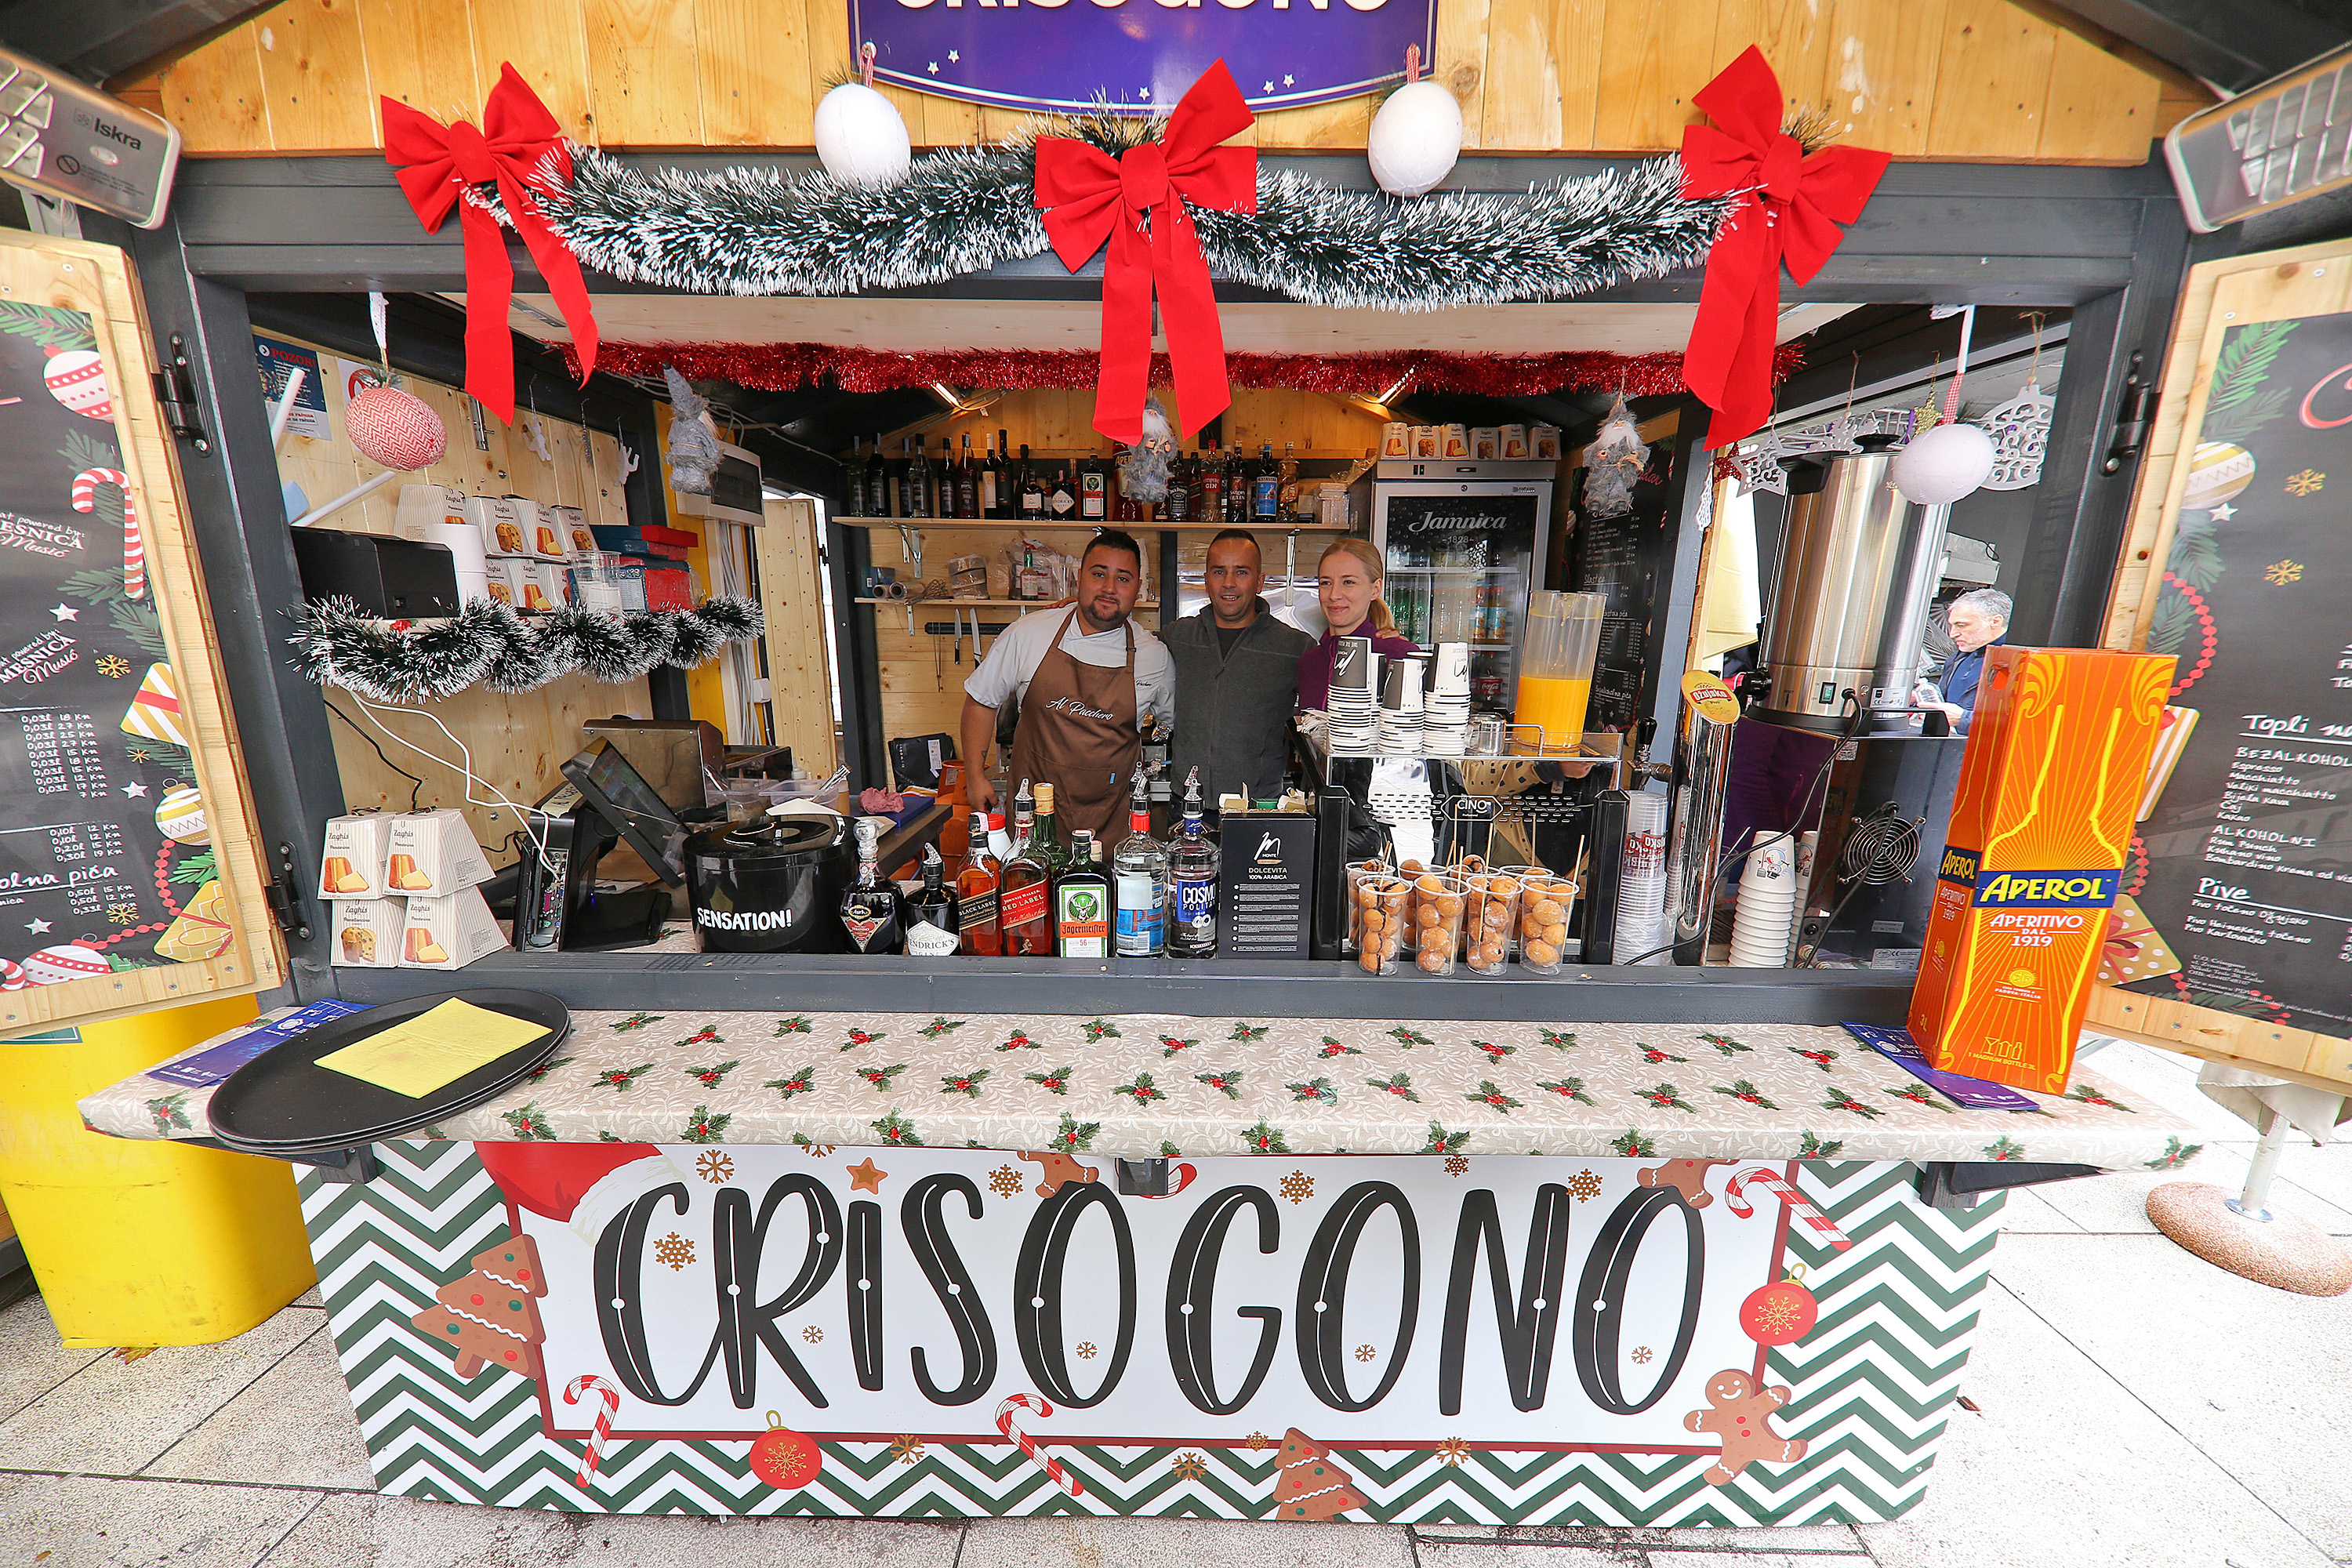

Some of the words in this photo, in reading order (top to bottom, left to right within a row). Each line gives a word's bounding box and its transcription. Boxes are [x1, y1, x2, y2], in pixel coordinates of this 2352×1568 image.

[94, 118, 142, 151] Iskra
[270, 348, 317, 368] POZOR!
[16, 517, 63, 532] powered
[1407, 511, 1508, 532] Jamnica
[0, 520, 85, 550] ESNICA
[11, 636, 45, 662] powered
[0, 635, 78, 684] MESNICA
[1693, 689, 1729, 701] Ožujsko
[1045, 696, 1069, 710] Al
[1069, 701, 1114, 720] Pacchero
[59, 713, 72, 721] 18
[2241, 713, 2310, 737] Topli
[61, 739, 78, 748] 27
[2234, 746, 2352, 768] BEZALKOHOL
[2230, 761, 2284, 773] Espresso
[2228, 772, 2301, 786] Macchiatto
[2222, 790, 2259, 804] Bijela
[2225, 781, 2259, 793] Veliki
[2261, 787, 2337, 801] macchiatto
[1457, 799, 1488, 811] CINO
[2219, 800, 2243, 814] Čaj
[2216, 811, 2252, 822] Kakao
[86, 824, 100, 833] 12
[393, 829, 414, 838] Zaghis
[2212, 824, 2317, 848] ALKOHOLNI
[2208, 836, 2235, 848] Rum
[2238, 840, 2278, 853] Punch
[2205, 845, 2254, 858] Kuhano
[2255, 854, 2283, 863] vino
[1940, 849, 1977, 880] APEROL
[2204, 853, 2274, 871] Bombardino
[2315, 871, 2336, 880] od
[1182, 883, 1216, 905] COSMO
[1939, 886, 1966, 906] APERITIVO
[1979, 873, 2107, 902] APEROL
[2197, 877, 2251, 900] Pive
[410, 904, 430, 913] Zaghis
[958, 906, 978, 916] BLACK
[978, 899, 997, 909] LABEL
[1002, 902, 1018, 912] RED
[1018, 894, 1044, 906] LABEL
[1004, 895, 1022, 905] JOHNNIE
[345, 905, 368, 913] Zaghis
[1941, 908, 1956, 921] 1919
[2190, 898, 2212, 909] Pivo
[2214, 902, 2257, 917] točeno
[2258, 909, 2310, 926] Ožujsko
[697, 906, 793, 931] SENSATION!
[1989, 913, 2085, 929] APERITIVO
[1062, 924, 1105, 935] Jägermeister
[2020, 927, 2047, 936] DAL
[2183, 923, 2205, 935] Pivo
[2206, 927, 2268, 946] Karlovačko
[2186, 915, 2207, 926] Pivo
[2209, 919, 2265, 937] Heineken
[2267, 929, 2313, 945] točeno
[909, 937, 955, 949] ENDRICK'S
[2010, 935, 2053, 947] 1919
[1994, 988, 2042, 1000] PADOVA-ITALIA
[1973, 1053, 2002, 1064] MAGNUM
[2002, 1058, 2028, 1069] BOTTLE
[593, 1171, 1706, 1416] CRISOGONO
